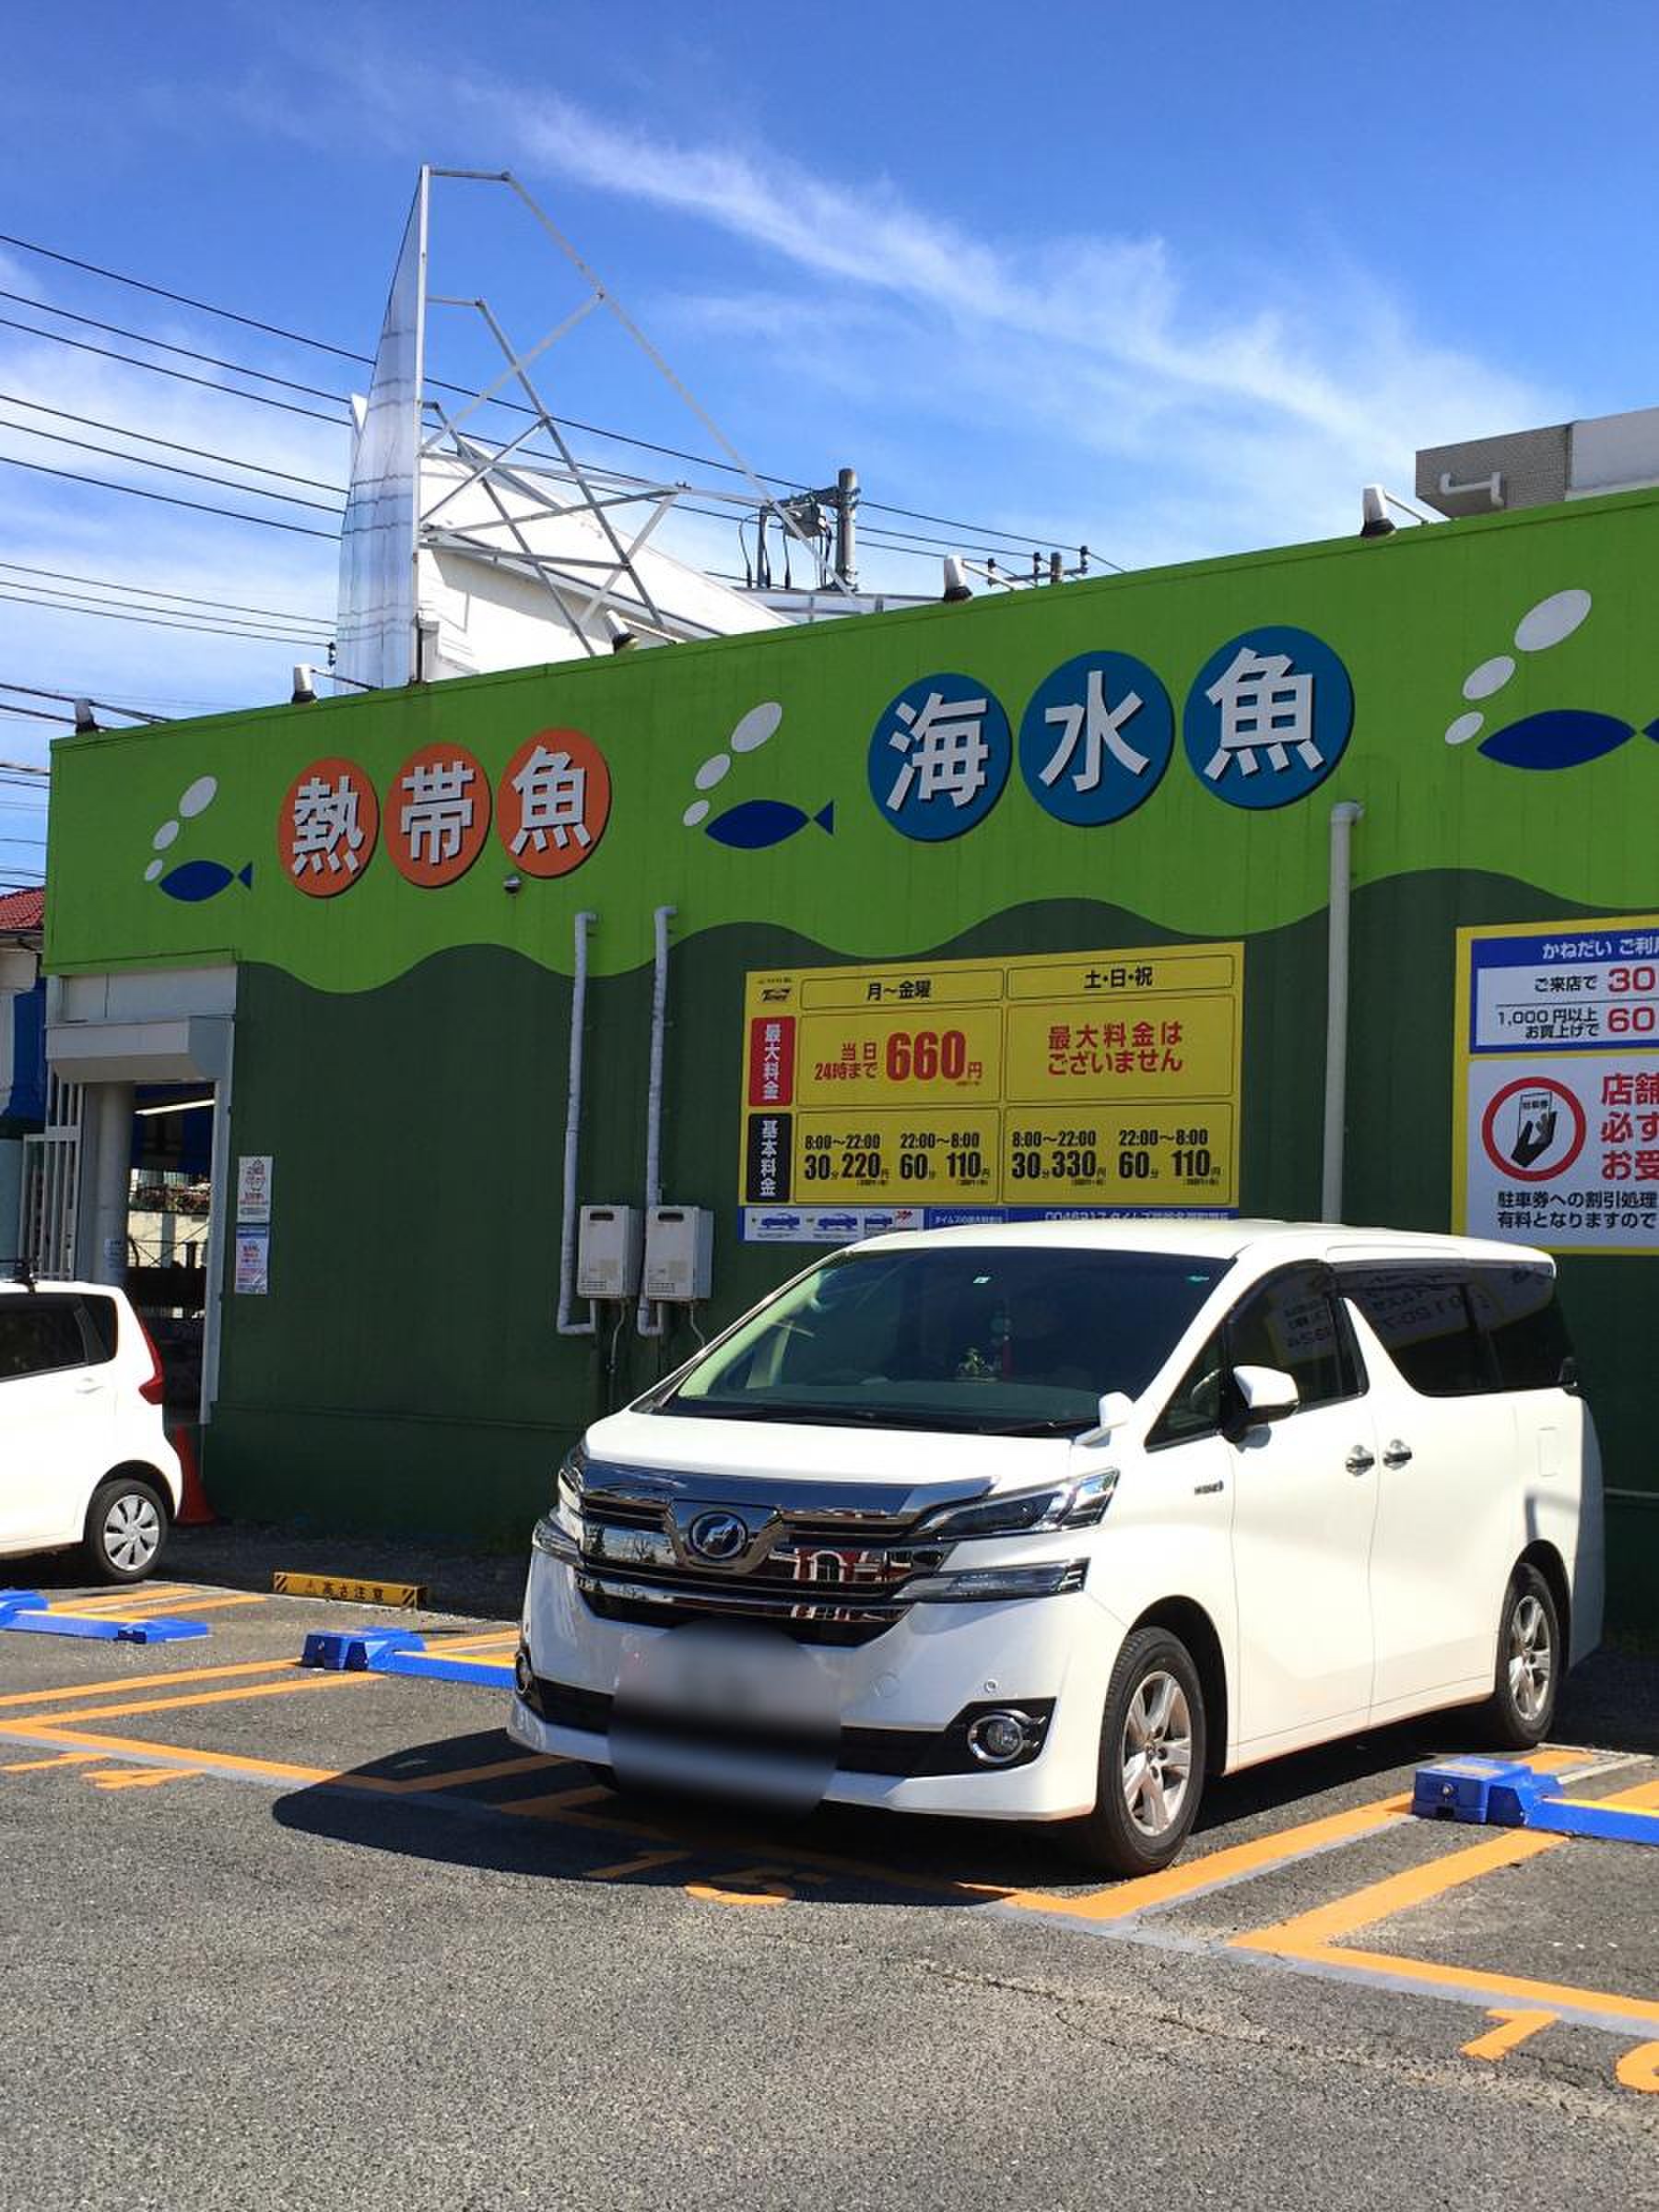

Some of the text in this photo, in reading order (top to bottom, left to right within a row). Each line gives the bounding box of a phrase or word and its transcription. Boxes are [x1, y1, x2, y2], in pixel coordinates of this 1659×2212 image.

[887, 647, 1324, 812] 海水魚
[293, 745, 591, 876] 熱帯魚
[1542, 939, 1612, 959] かねだい
[1084, 967, 1152, 989] 土・日・祝
[1535, 974, 1597, 993] ご来店で
[1607, 966, 1655, 993] 30
[1524, 1023, 1599, 1039] お買上げで
[1607, 1006, 1655, 1032] 60
[1048, 1021, 1183, 1050] 最大料金は
[763, 1024, 782, 1100] 最大料金
[815, 1061, 877, 1081] 24時まで
[1048, 1049, 1183, 1076] ございません
[760, 1120, 777, 1196] 基本料金
[1498, 1191, 1658, 1209] 駐車券への割引処理
[1498, 1211, 1657, 1230] 有料となりますので
[324, 1581, 383, 1600] 高さ注意
